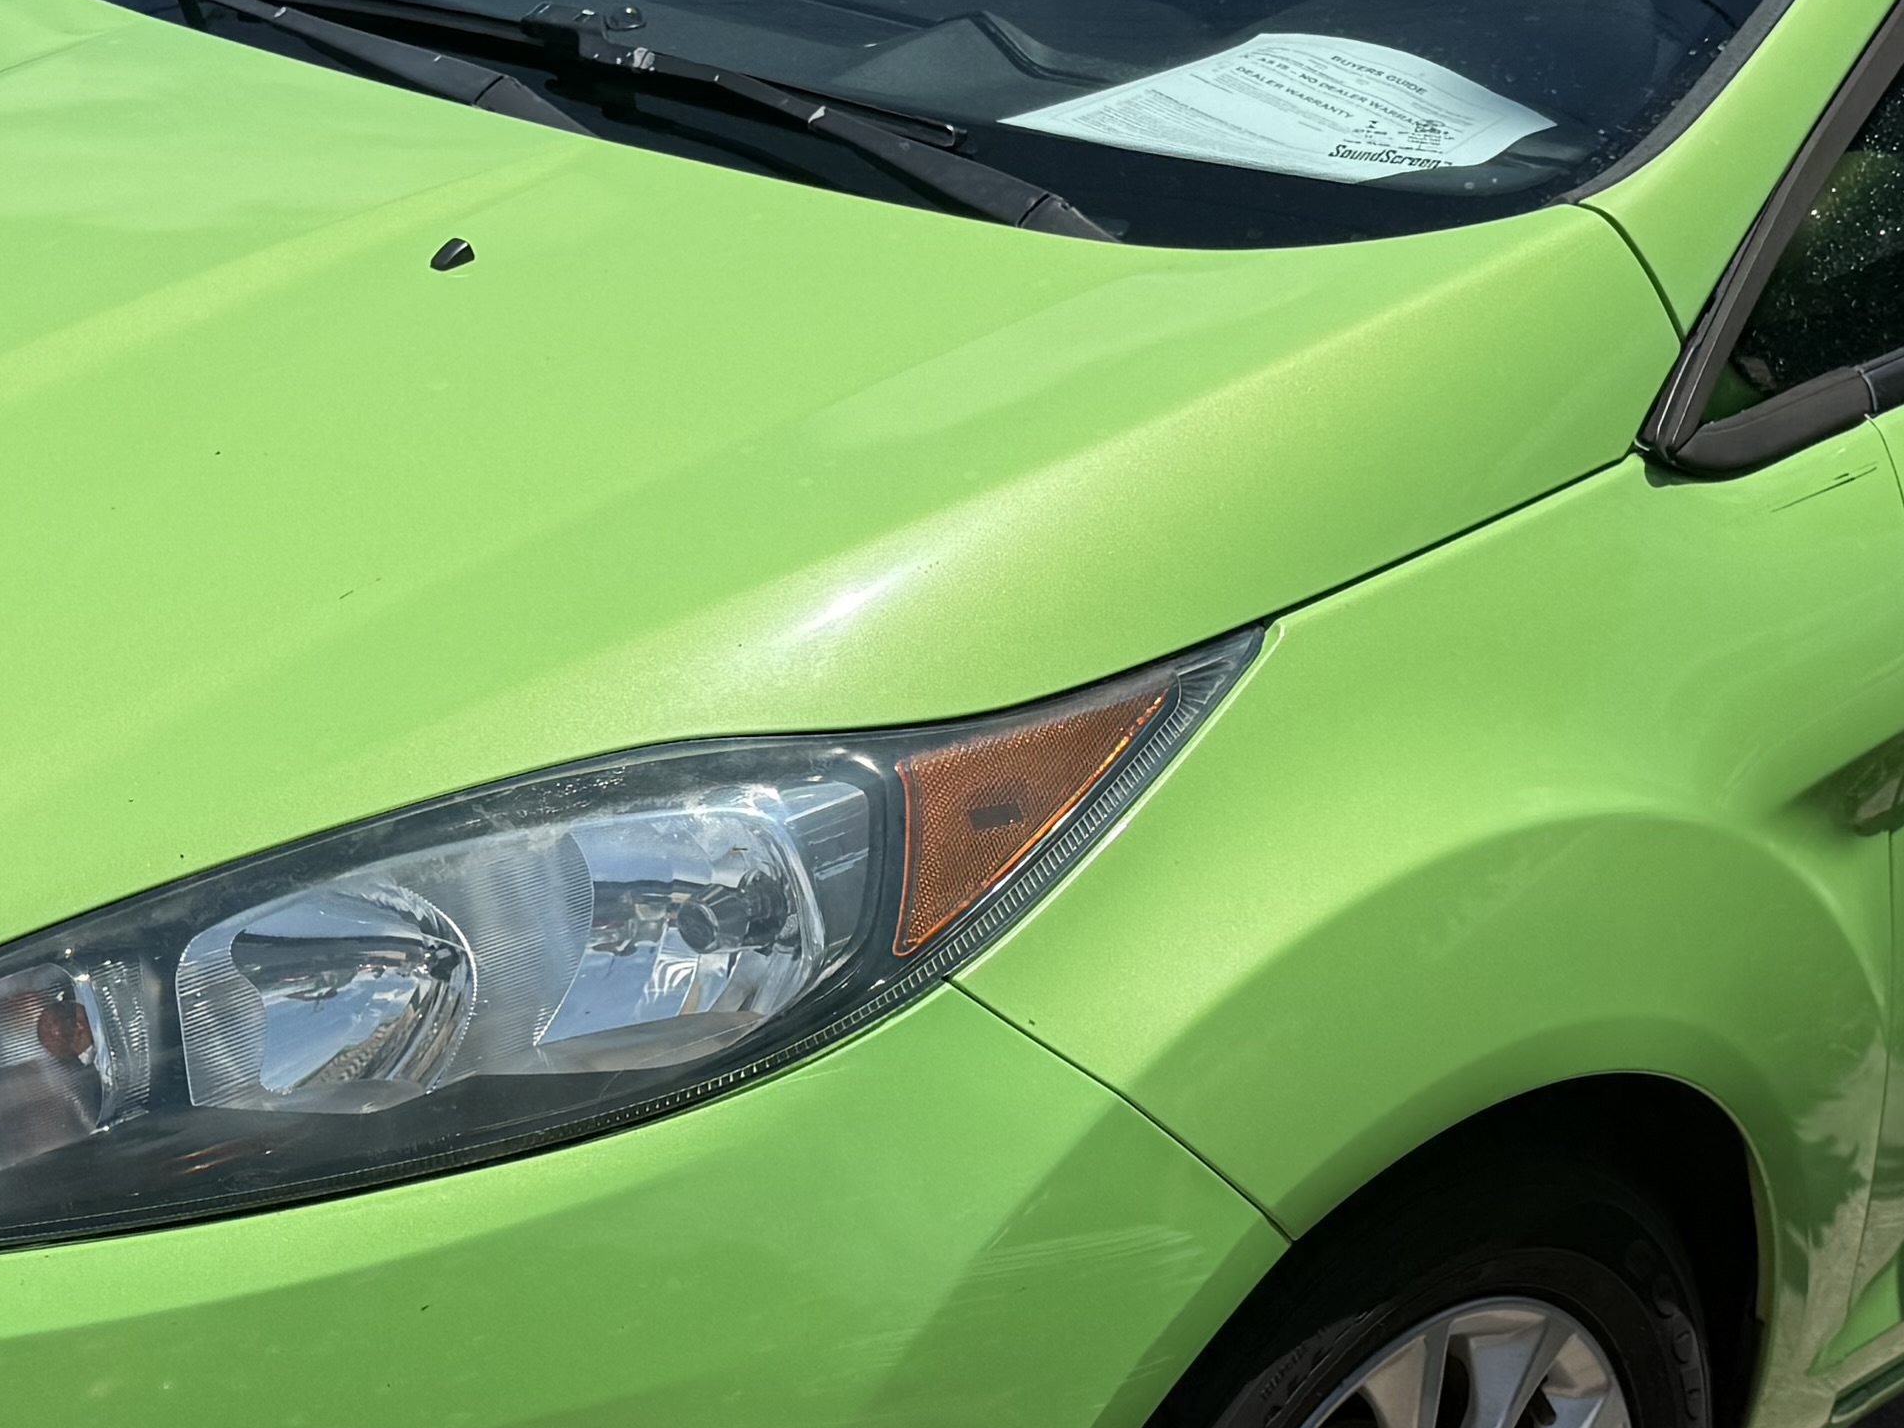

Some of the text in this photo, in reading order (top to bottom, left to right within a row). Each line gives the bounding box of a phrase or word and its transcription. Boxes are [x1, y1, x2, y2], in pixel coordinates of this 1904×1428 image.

[1235, 65, 1355, 120] DEALER WARRANTY
[1298, 72, 1319, 85] NO
[1318, 81, 1369, 103] DEALER
[1330, 54, 1429, 96] BUYERS GUIDE
